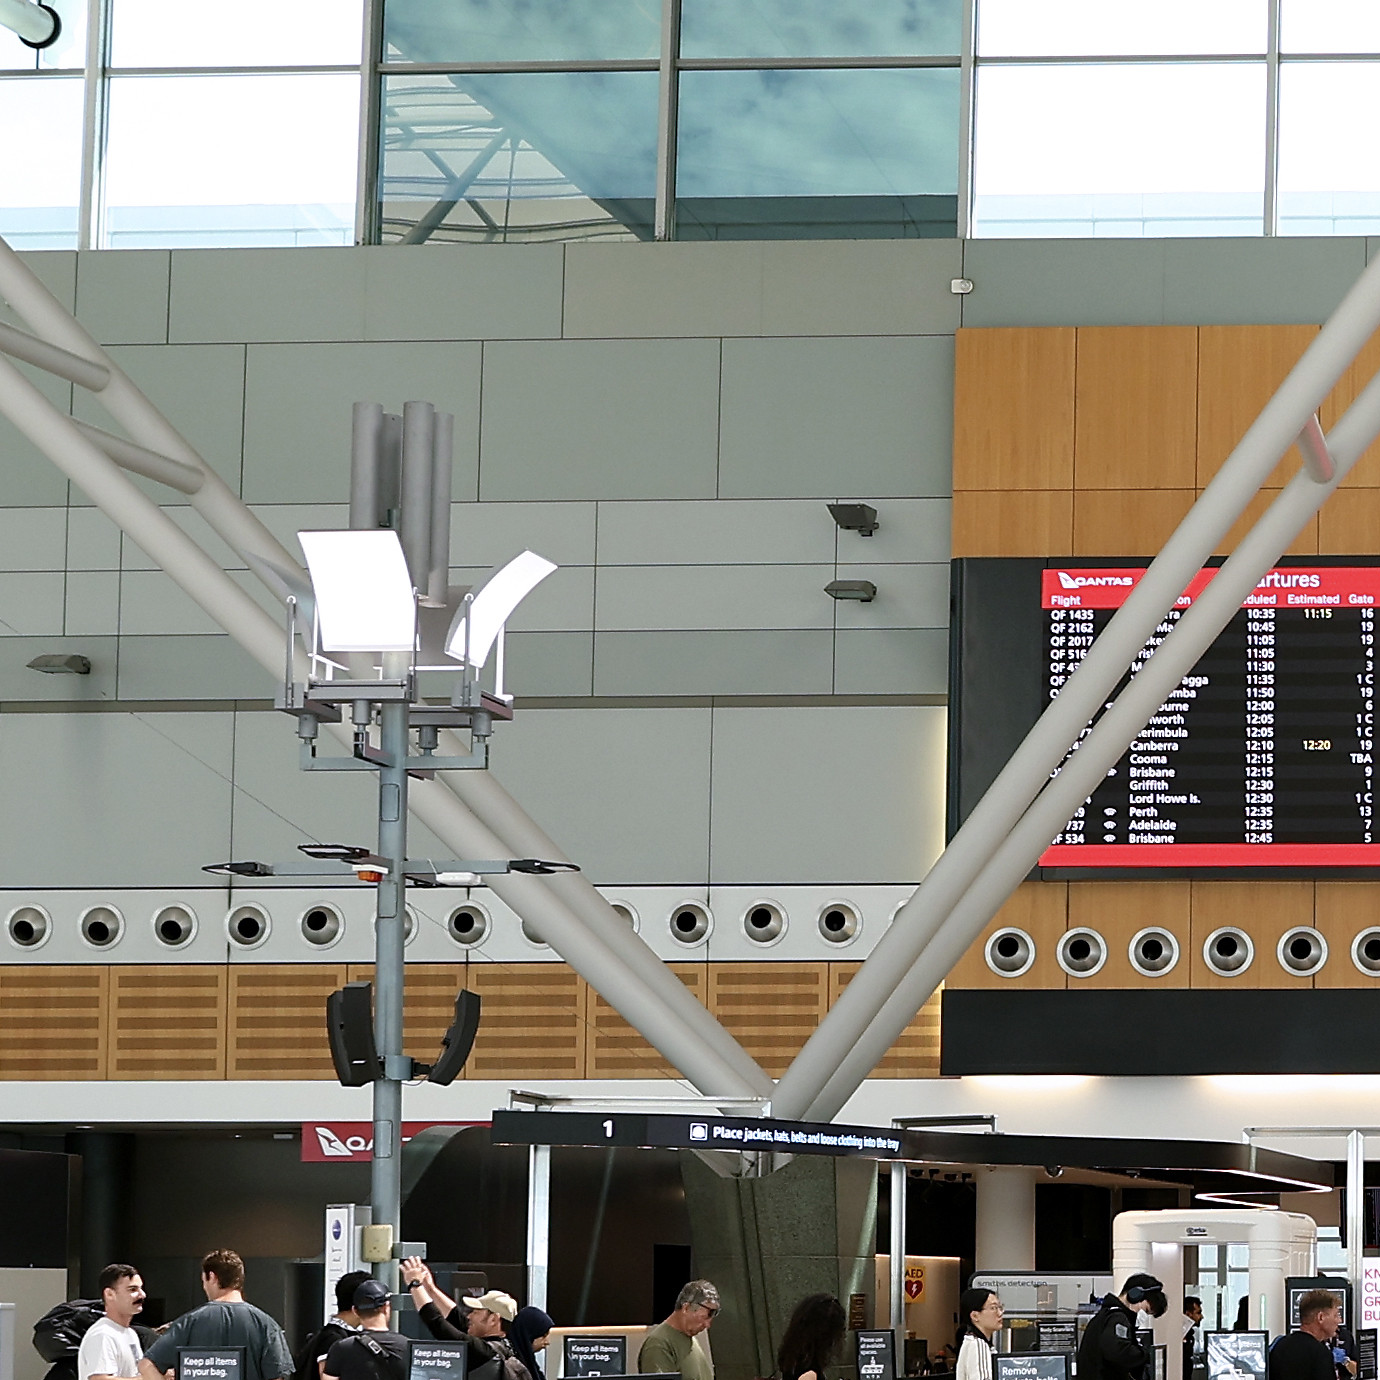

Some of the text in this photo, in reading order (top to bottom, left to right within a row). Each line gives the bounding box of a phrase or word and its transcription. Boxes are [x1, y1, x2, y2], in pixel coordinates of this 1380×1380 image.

[1074, 577, 1132, 588] QANTAS
[1051, 595, 1081, 607] Flight
[1288, 594, 1340, 604] Estimated
[1349, 594, 1374, 604] Gate
[1051, 610, 1066, 621] QF
[1069, 610, 1093, 620] 1435
[1248, 609, 1275, 618] 10:35
[1304, 609, 1332, 618] 11:15
[1361, 608, 1374, 618] 16
[1129, 740, 1178, 751] Canberra
[1246, 741, 1274, 750] 12:10
[1303, 740, 1330, 750] 12:20
[1360, 740, 1372, 750] 19
[1130, 754, 1167, 764] Cooma
[1246, 753, 1273, 763] 12:15
[1350, 753, 1372, 763] TBA
[1130, 793, 1273, 803] Lord Howe Is. 12:30
[603, 1120, 612, 1137] 1
[713, 1126, 743, 1139] Place
